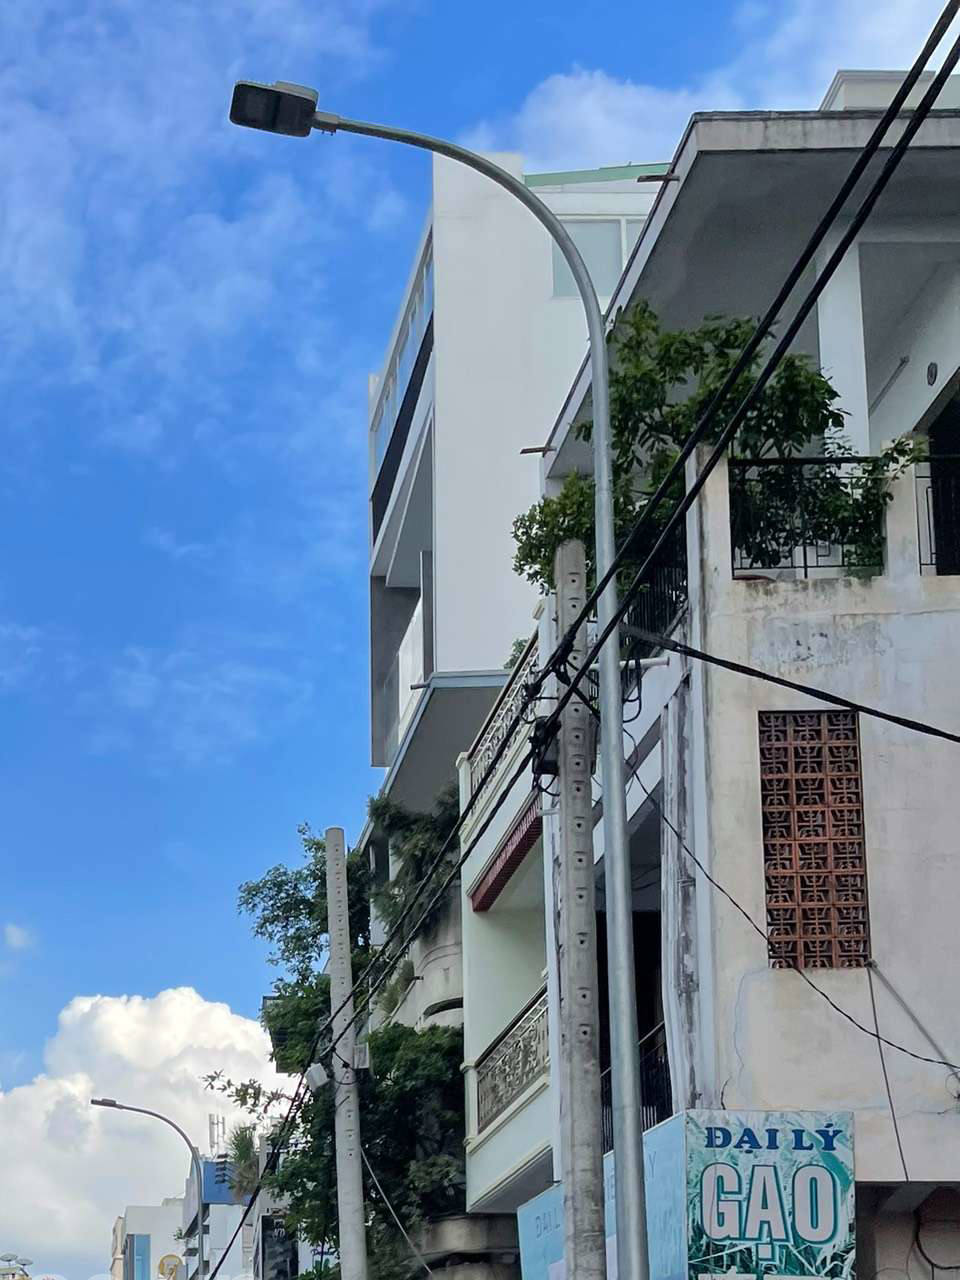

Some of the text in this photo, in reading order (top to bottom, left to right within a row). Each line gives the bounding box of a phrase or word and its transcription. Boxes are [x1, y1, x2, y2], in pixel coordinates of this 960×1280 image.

[705, 1122, 843, 1154] ĐẠI LÝ
[700, 1162, 838, 1264] GẠO
